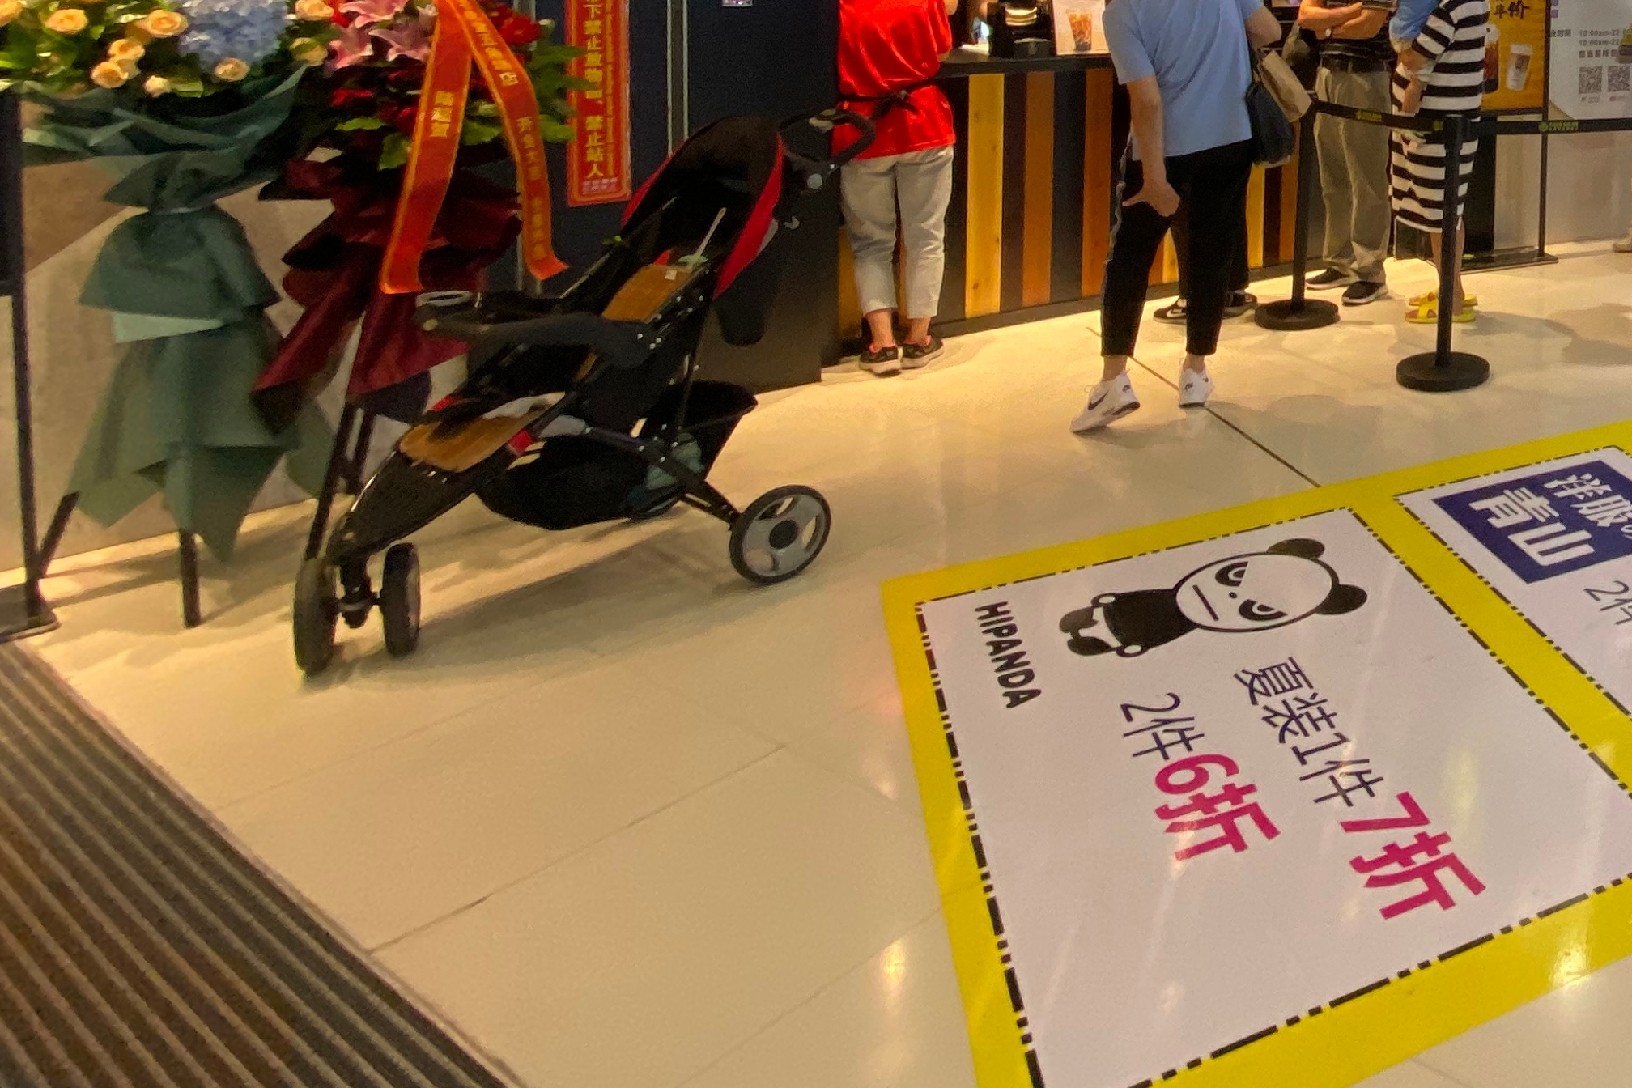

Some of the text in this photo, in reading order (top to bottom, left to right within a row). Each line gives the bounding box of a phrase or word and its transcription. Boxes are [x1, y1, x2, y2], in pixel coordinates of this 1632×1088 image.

[1470, 486, 1595, 567] 青山
[974, 600, 1041, 710] HIPANDA
[1120, 691, 1281, 860] 2件6折
[1235, 656, 1486, 921] 夏装1件7折
